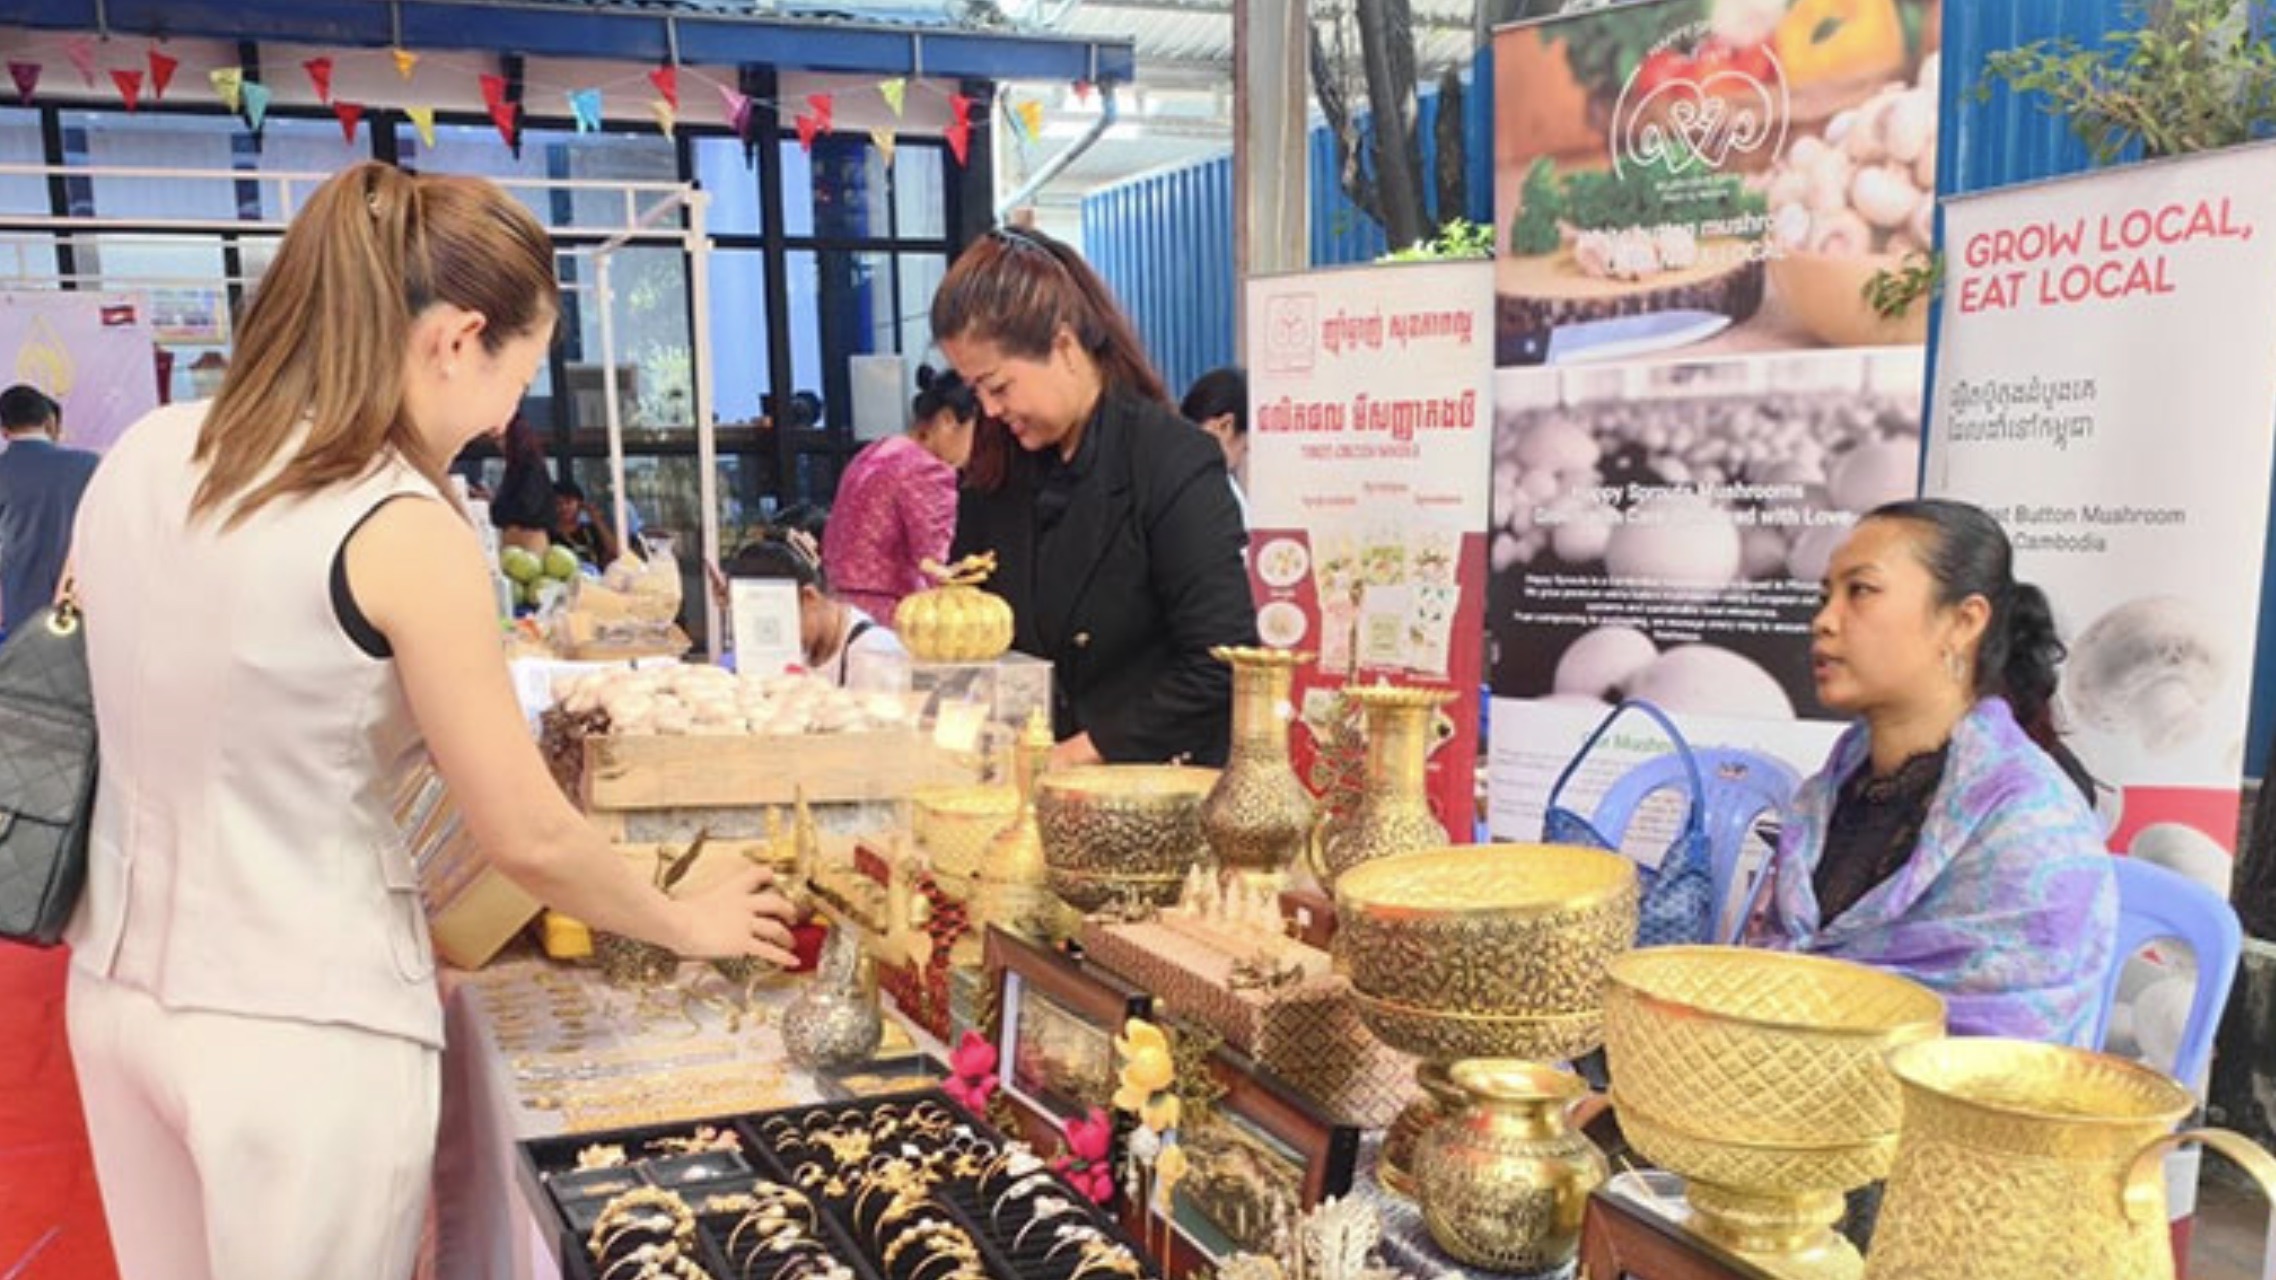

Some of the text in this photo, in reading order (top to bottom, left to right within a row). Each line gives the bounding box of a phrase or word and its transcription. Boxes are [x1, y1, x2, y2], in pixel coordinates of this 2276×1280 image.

[1965, 197, 2253, 268] GROW LOCAL,
[1959, 256, 2176, 313] EAT LOCAL
[2015, 505, 2077, 524] Button
[2081, 504, 2186, 525] Mushroom
[2014, 532, 2106, 552] Cambodia
